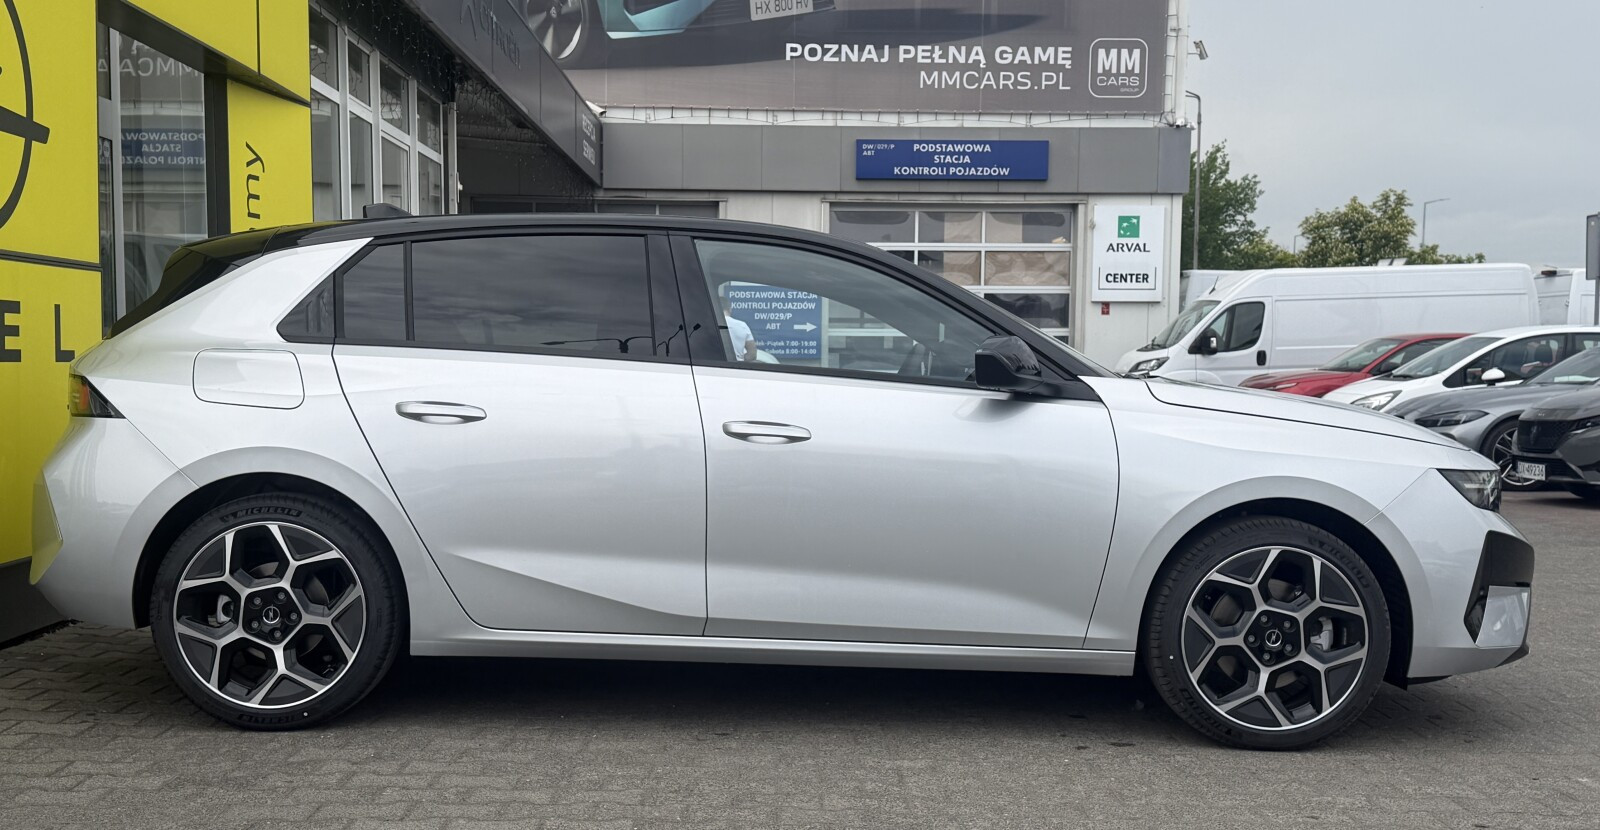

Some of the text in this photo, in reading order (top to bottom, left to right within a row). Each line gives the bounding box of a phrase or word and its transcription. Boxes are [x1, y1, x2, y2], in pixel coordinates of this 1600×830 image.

[755, 1, 771, 15] HX
[774, 0, 792, 12] 800
[785, 43, 1072, 68] POZNAJ PEŁNĄ GAMĘ
[1097, 48, 1140, 73] MM
[919, 70, 1071, 90] MMCARS.PL
[1097, 76, 1139, 86] CARS
[913, 143, 991, 152] PODSTAWOWA
[933, 155, 971, 163] STACJA
[893, 164, 1010, 176] KONTROLI POJAZDÓW
[246, 141, 265, 232] my
[1106, 242, 1151, 253] ARVAL
[1105, 273, 1149, 283] CENTER
[729, 291, 818, 299] PODSTAWOWA STACJA
[772, 301, 816, 309] POJAZDÓW
[237, 507, 298, 517] MICHELIN
